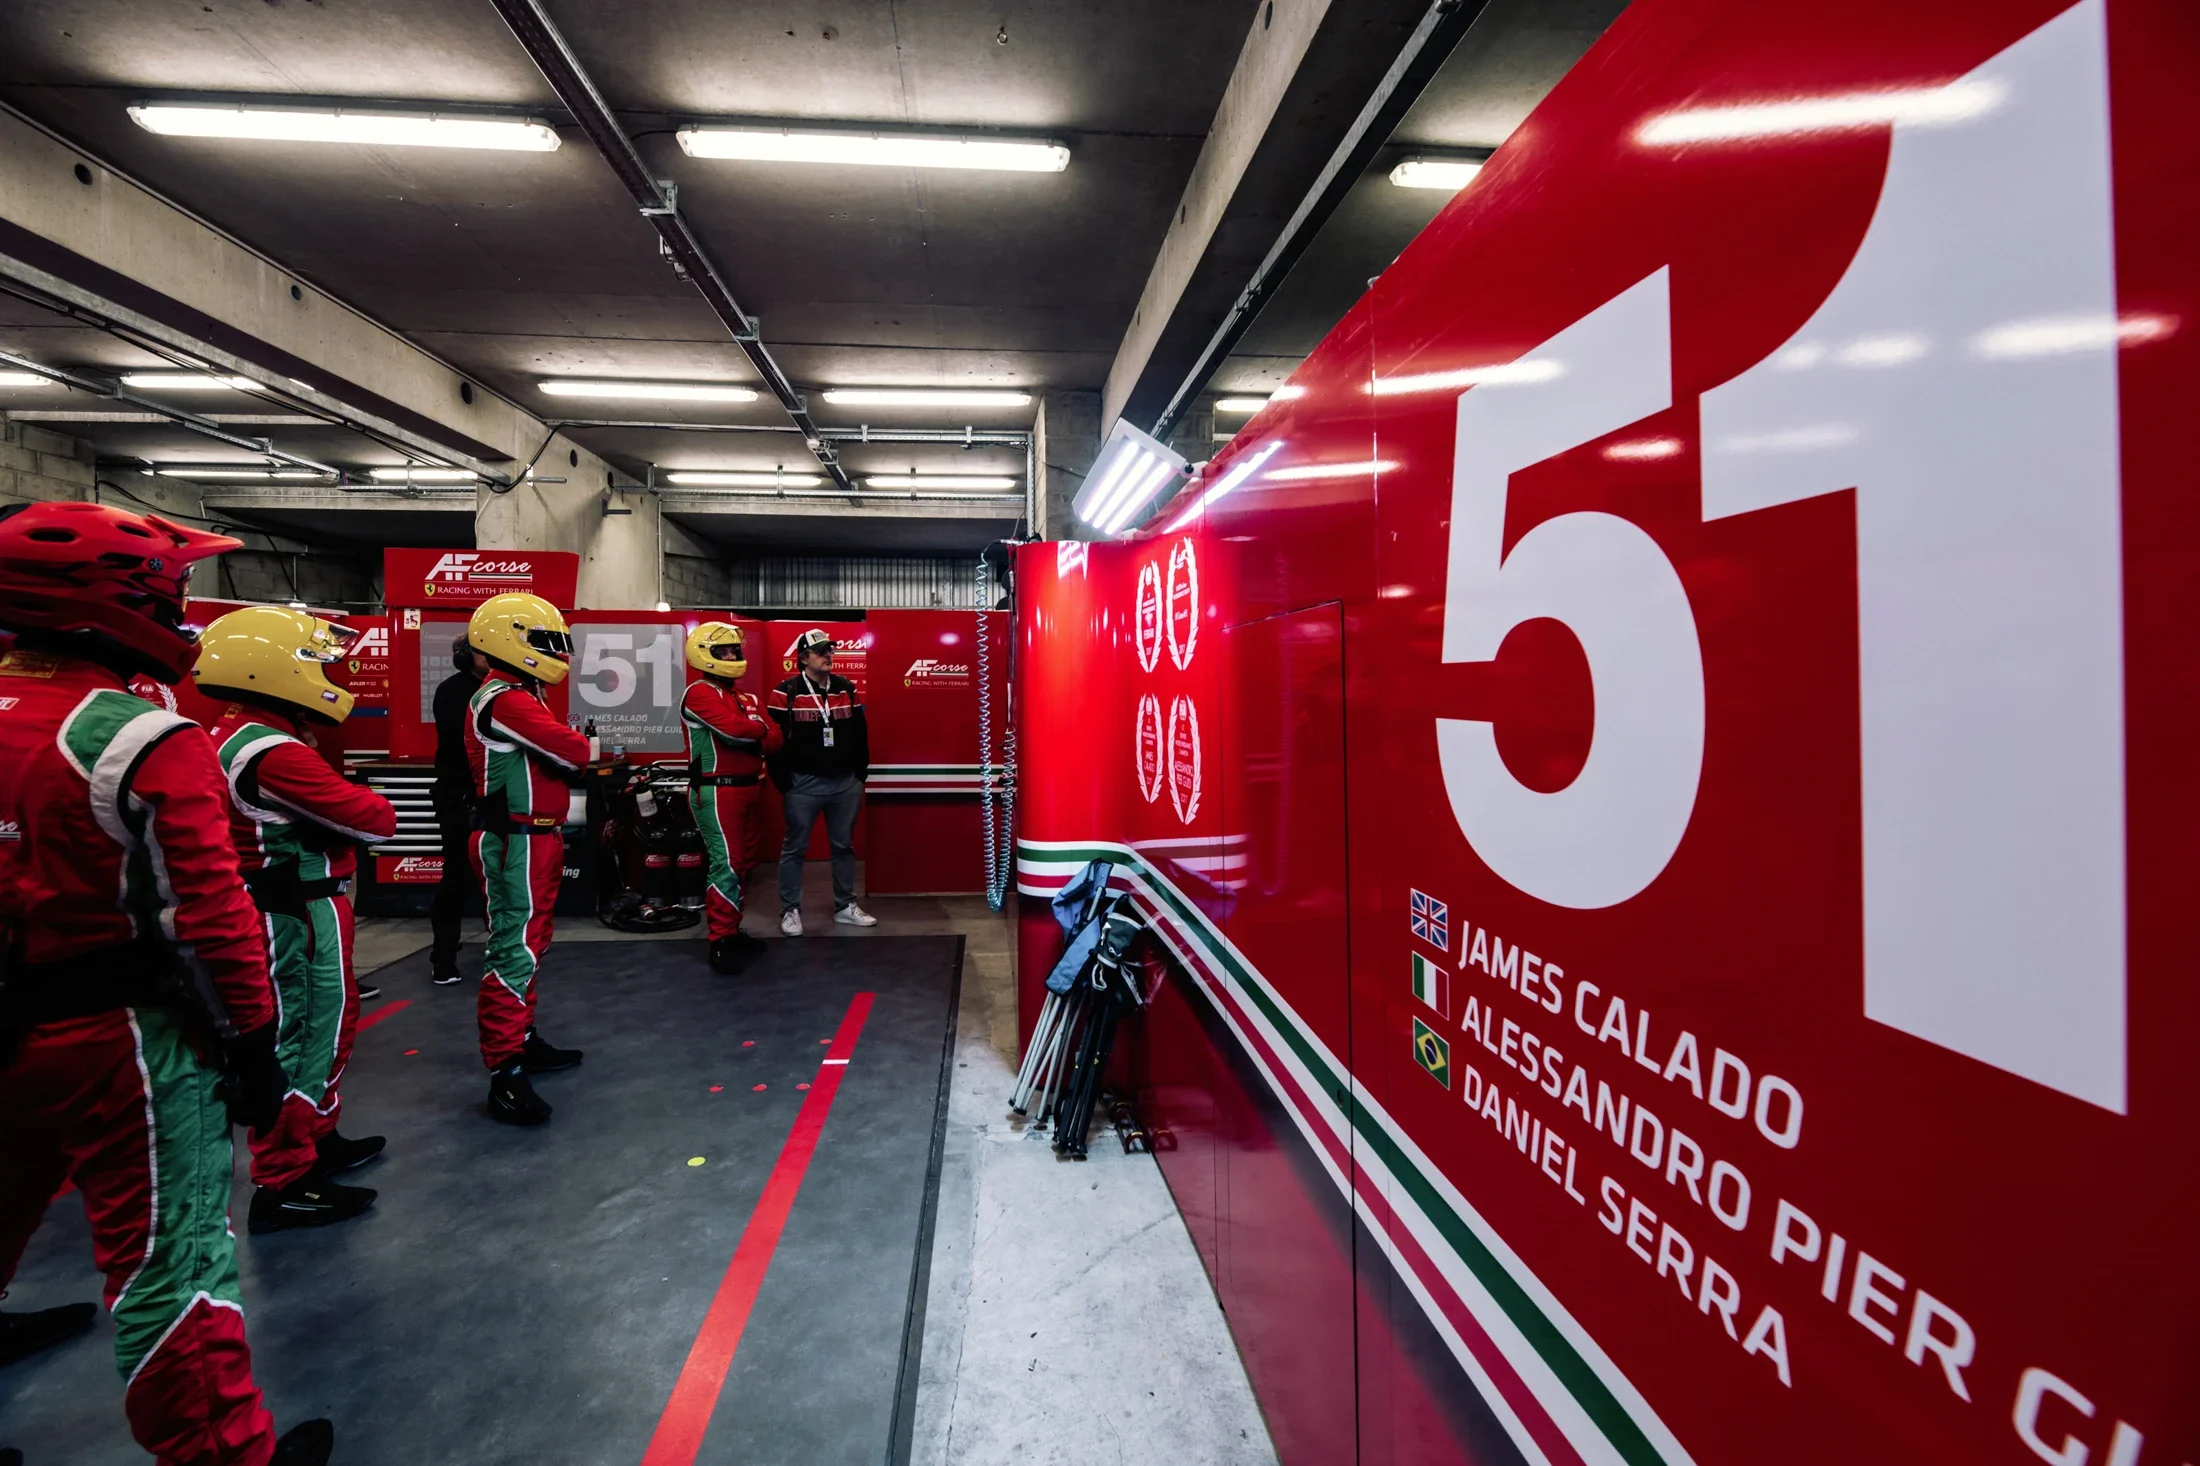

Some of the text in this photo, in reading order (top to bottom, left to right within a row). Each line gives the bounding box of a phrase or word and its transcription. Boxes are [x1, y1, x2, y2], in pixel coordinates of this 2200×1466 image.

[437, 586, 471, 594] RACING
[1435, 0, 2127, 1115] 51
[577, 633, 672, 708] 51
[613, 714, 648, 722] CALADO
[643, 726, 663, 734] PIER
[1458, 920, 1804, 1150] JAMES CALADO
[1460, 995, 1752, 1232] ALESSANDRO
[1770, 1197, 1977, 1404] PIER
[1463, 1063, 1793, 1389] DANIEL SERRA
